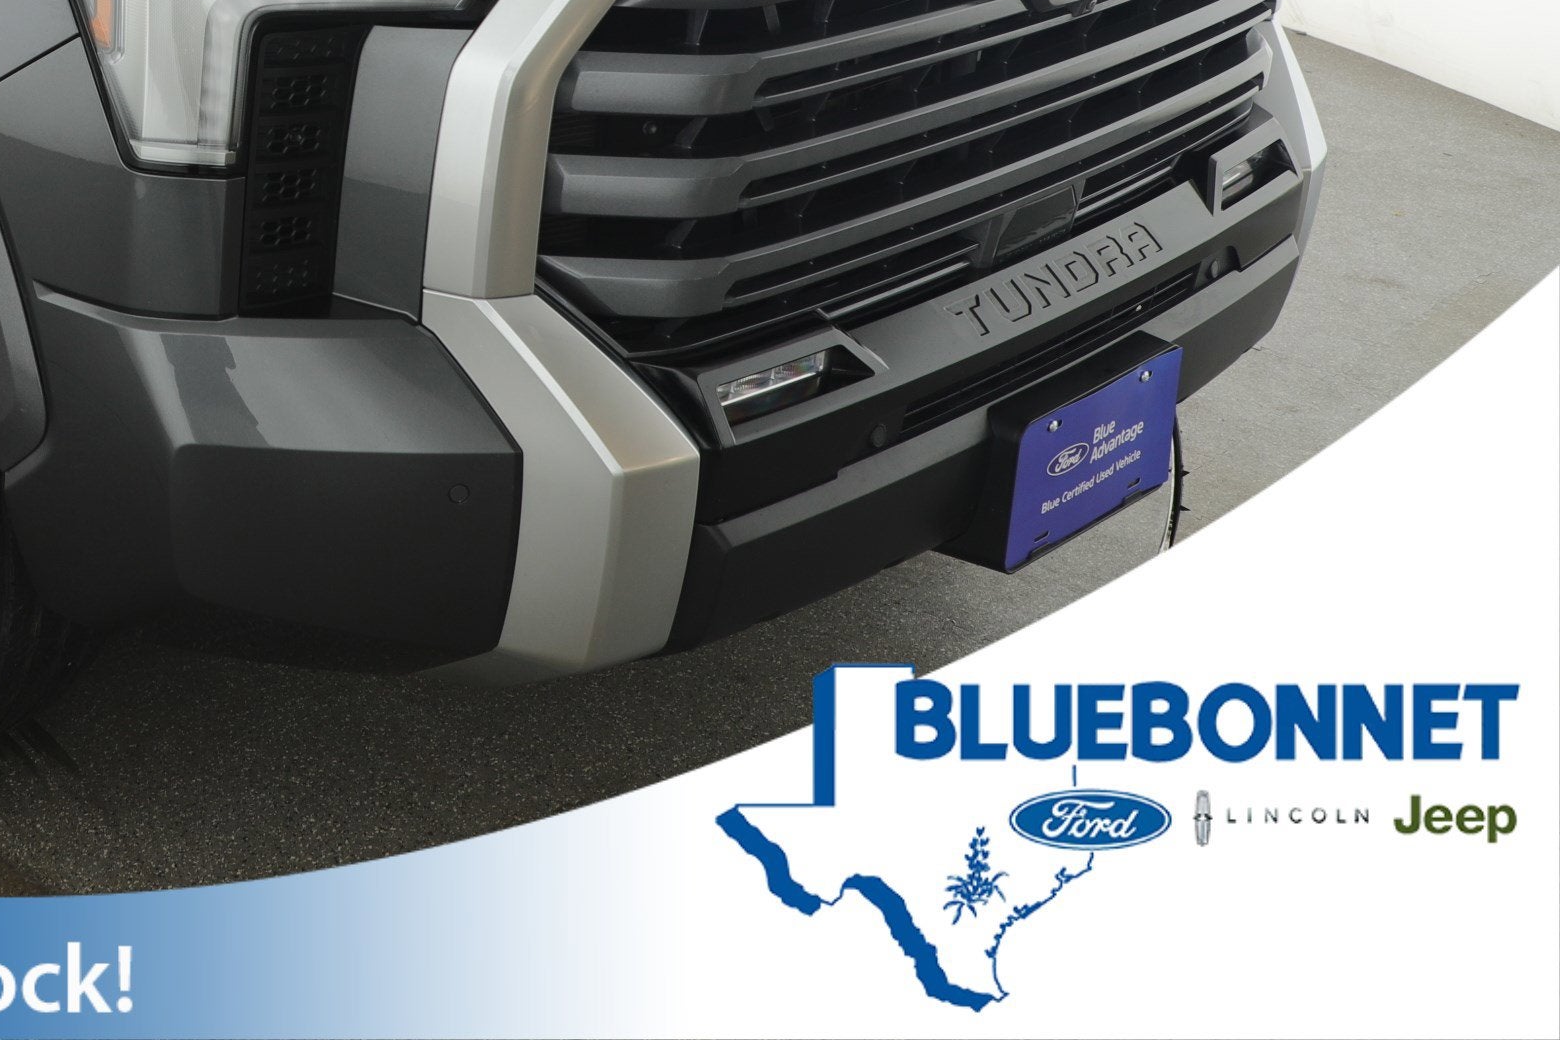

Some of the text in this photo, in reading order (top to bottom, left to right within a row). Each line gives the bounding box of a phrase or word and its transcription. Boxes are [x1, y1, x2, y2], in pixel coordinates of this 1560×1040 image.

[943, 221, 1164, 336] TUNDRA
[1089, 421, 1144, 463] Advantage
[1092, 420, 1116, 444] Blue
[1041, 449, 1141, 514] Blue Certified Used Vehicle
